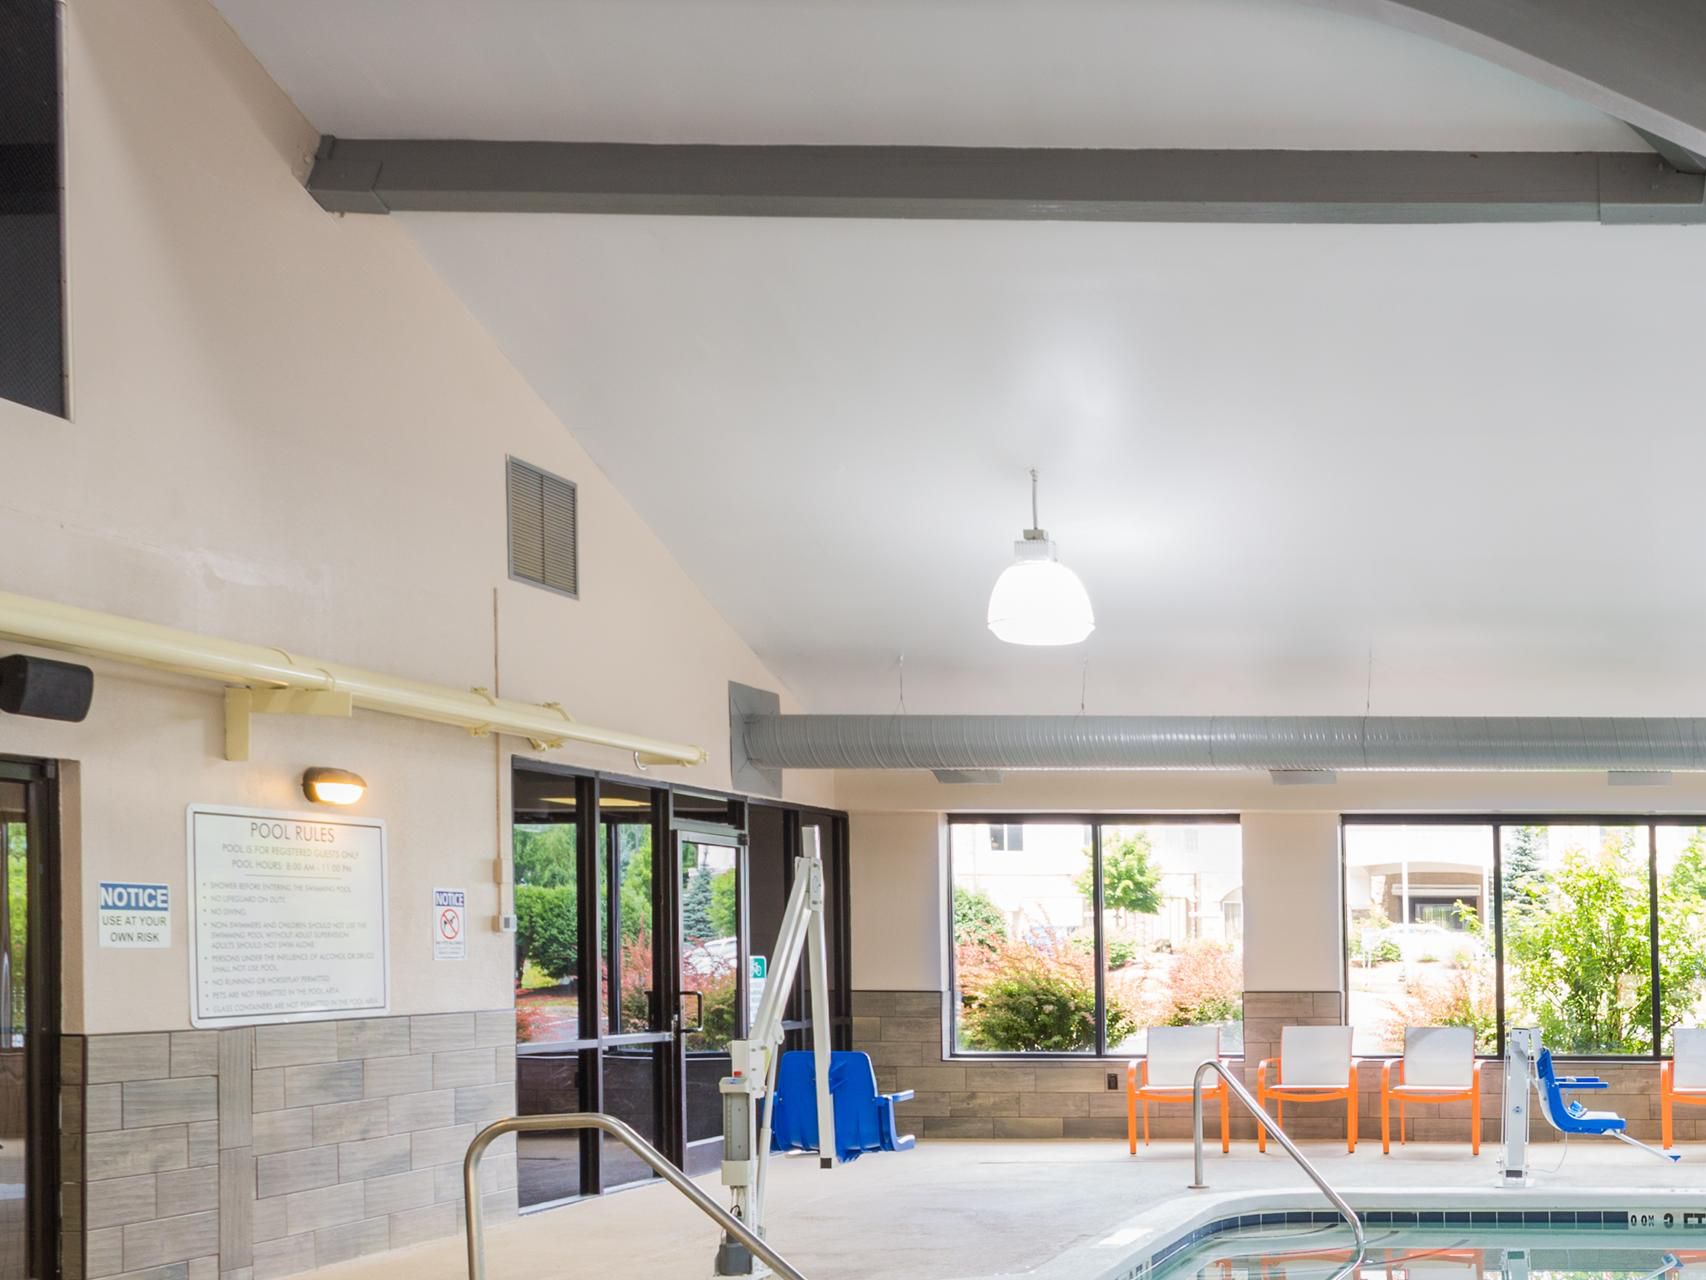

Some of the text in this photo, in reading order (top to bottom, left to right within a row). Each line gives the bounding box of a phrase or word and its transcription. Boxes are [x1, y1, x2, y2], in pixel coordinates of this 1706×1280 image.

[251, 822, 335, 843] POOL RULES
[222, 843, 359, 860] POOL IS FOR REGISTERED GUESTS ONLY
[232, 859, 253, 869] POOL
[304, 864, 315, 872] AM
[342, 865, 352, 873] PM
[101, 887, 168, 908] NOTICE
[436, 893, 464, 906] NOTICE
[102, 915, 167, 926] USE AT YOUR
[110, 931, 160, 943] OWN RISK
